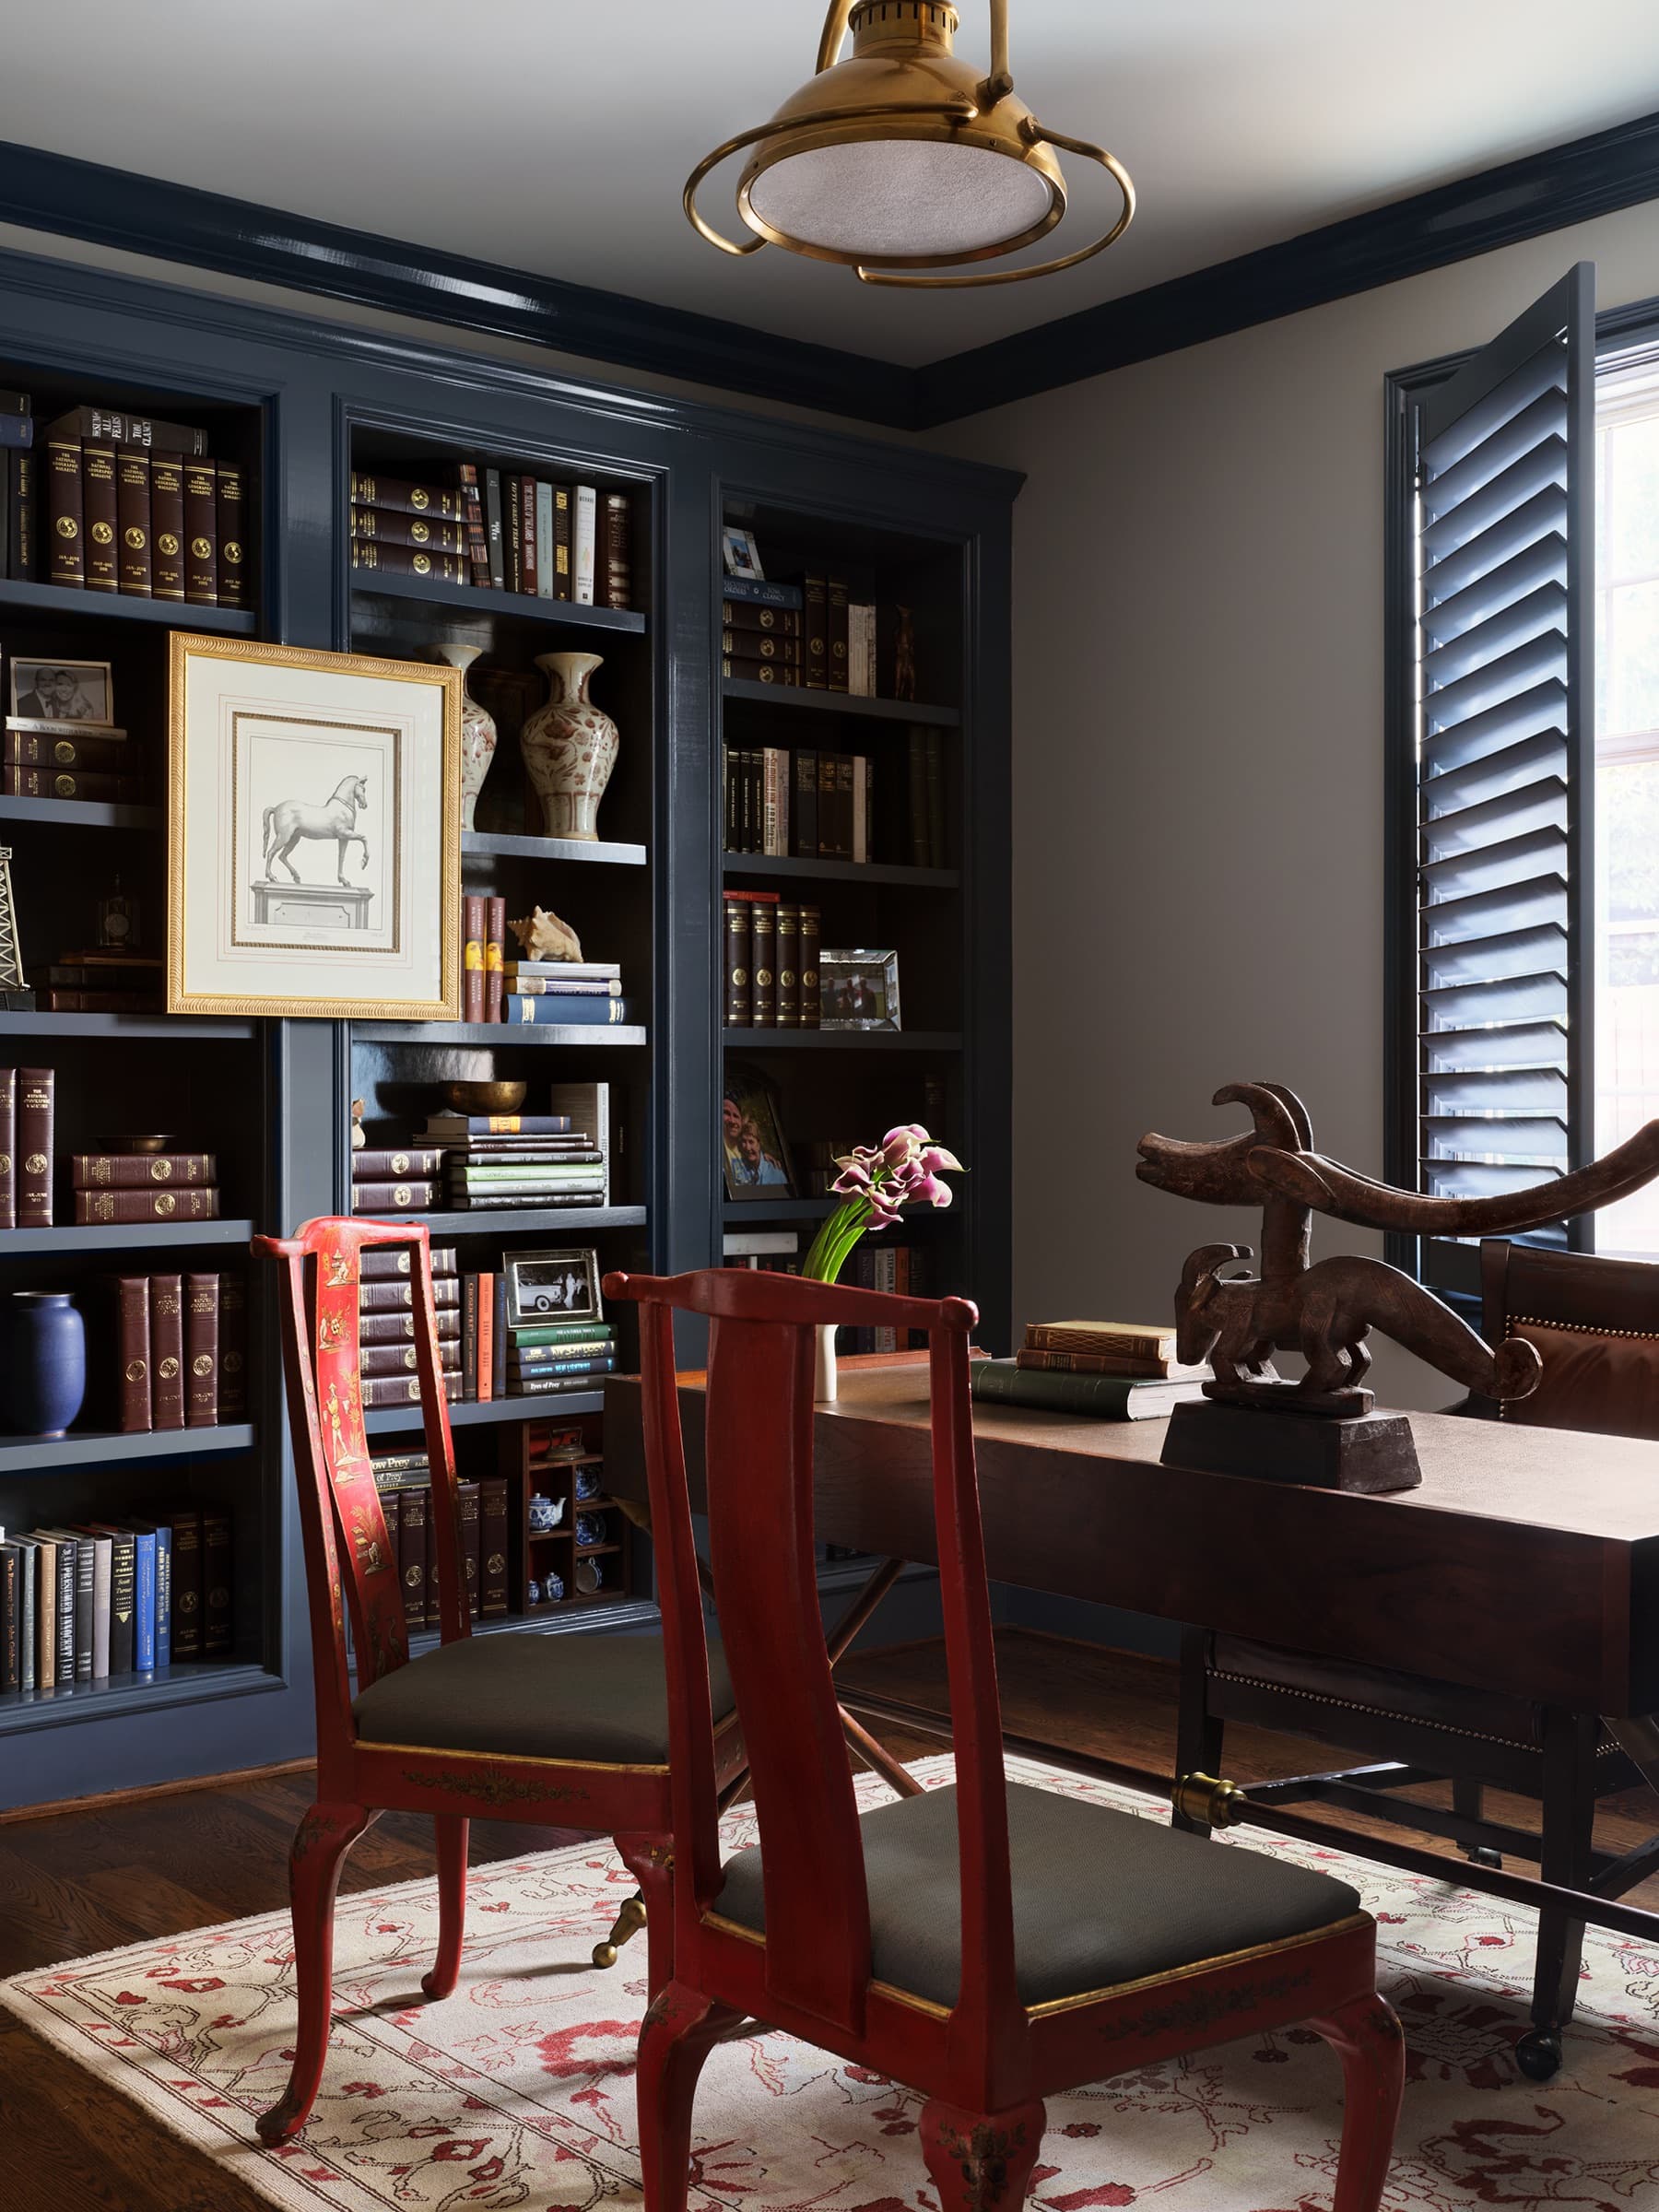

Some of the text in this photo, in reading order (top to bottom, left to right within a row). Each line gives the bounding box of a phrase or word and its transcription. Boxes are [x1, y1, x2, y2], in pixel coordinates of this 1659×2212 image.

[103, 418, 112, 433] ALL
[112, 416, 122, 439] FEARS
[132, 424, 142, 438] TOM
[142, 421, 152, 447] CLANCY
[556, 491, 568, 510] KEN
[387, 1458, 410, 1470] Prey
[60, 1567, 73, 1657] PRESUMED INNOCENT
